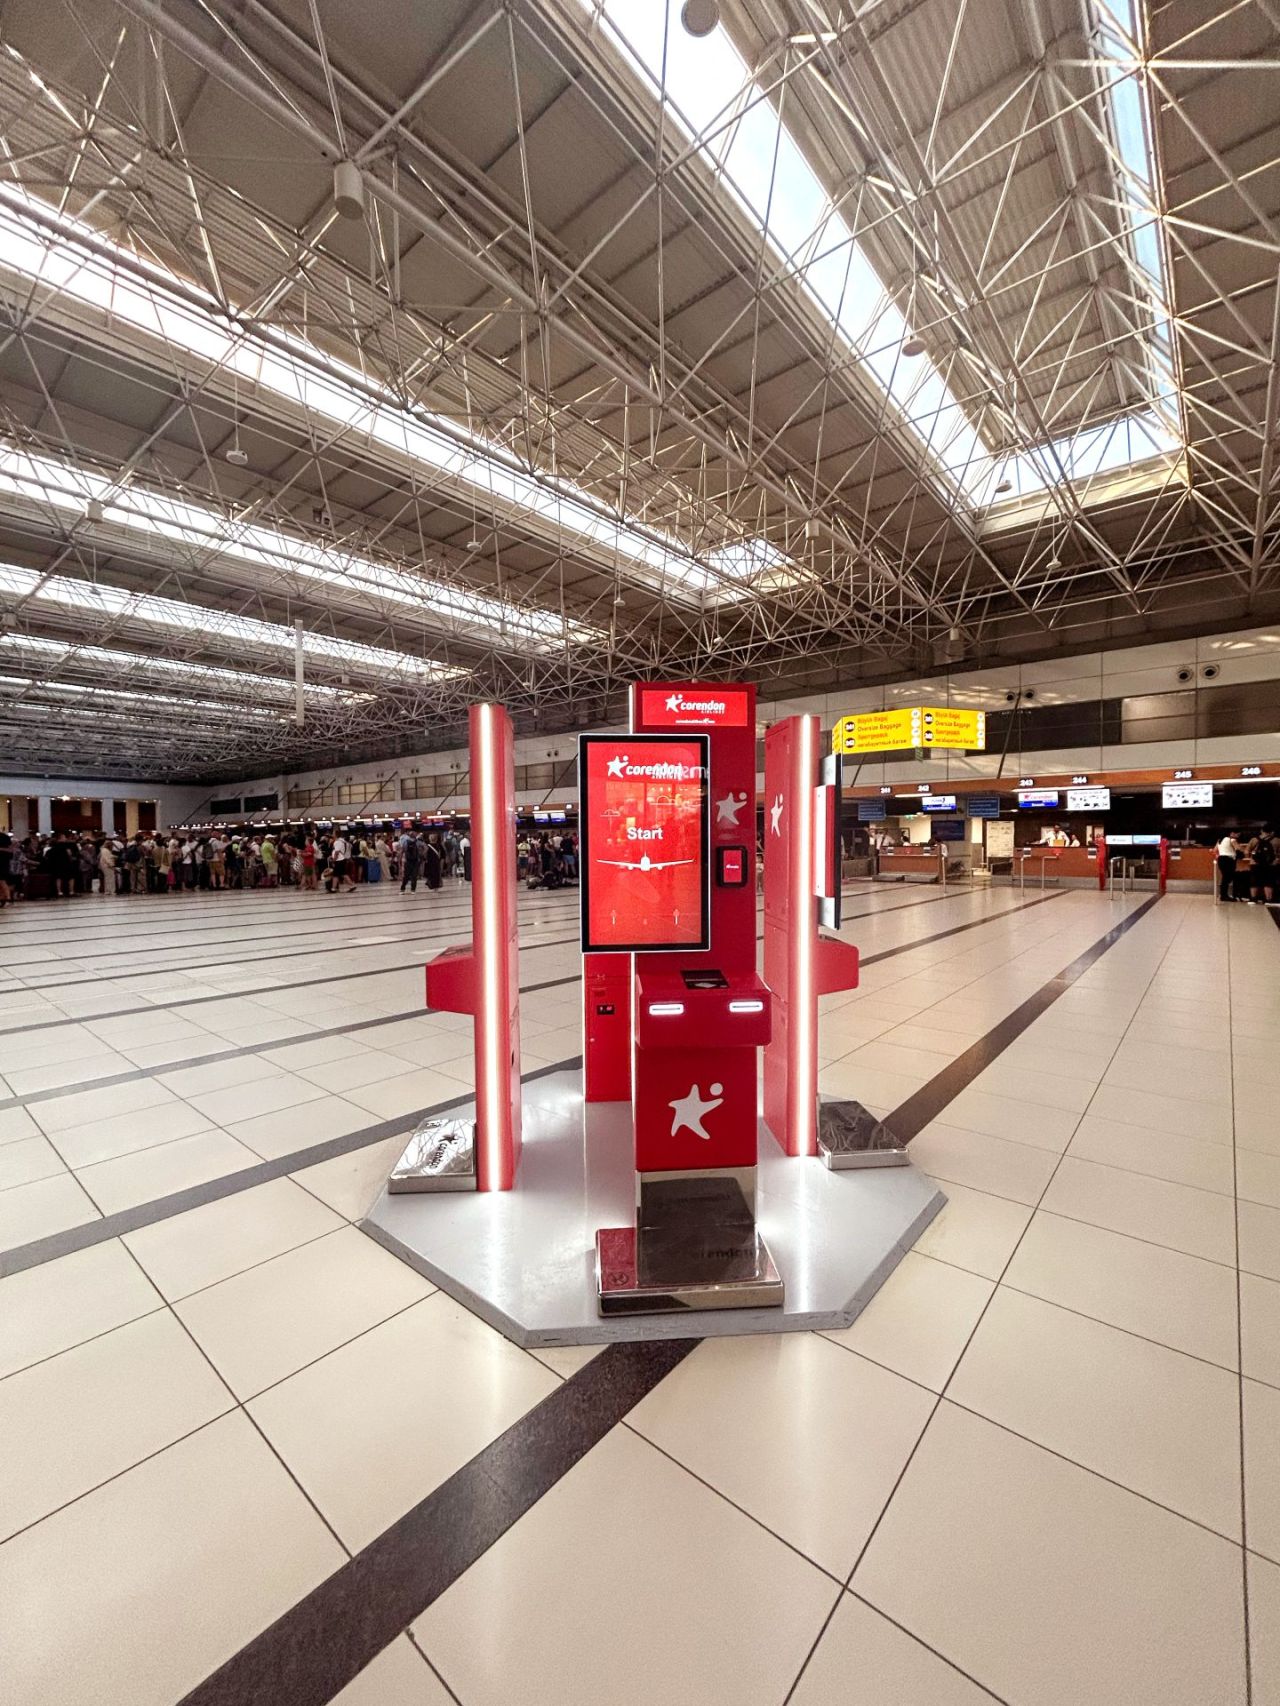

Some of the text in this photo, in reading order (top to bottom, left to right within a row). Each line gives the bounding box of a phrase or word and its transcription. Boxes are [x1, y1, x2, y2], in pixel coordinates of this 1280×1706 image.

[680, 700, 725, 711] corendon
[858, 722, 902, 732] Oversize Baggage
[625, 762, 682, 775] corendon
[1174, 770, 1192, 779] 245
[627, 827, 663, 841] Start
